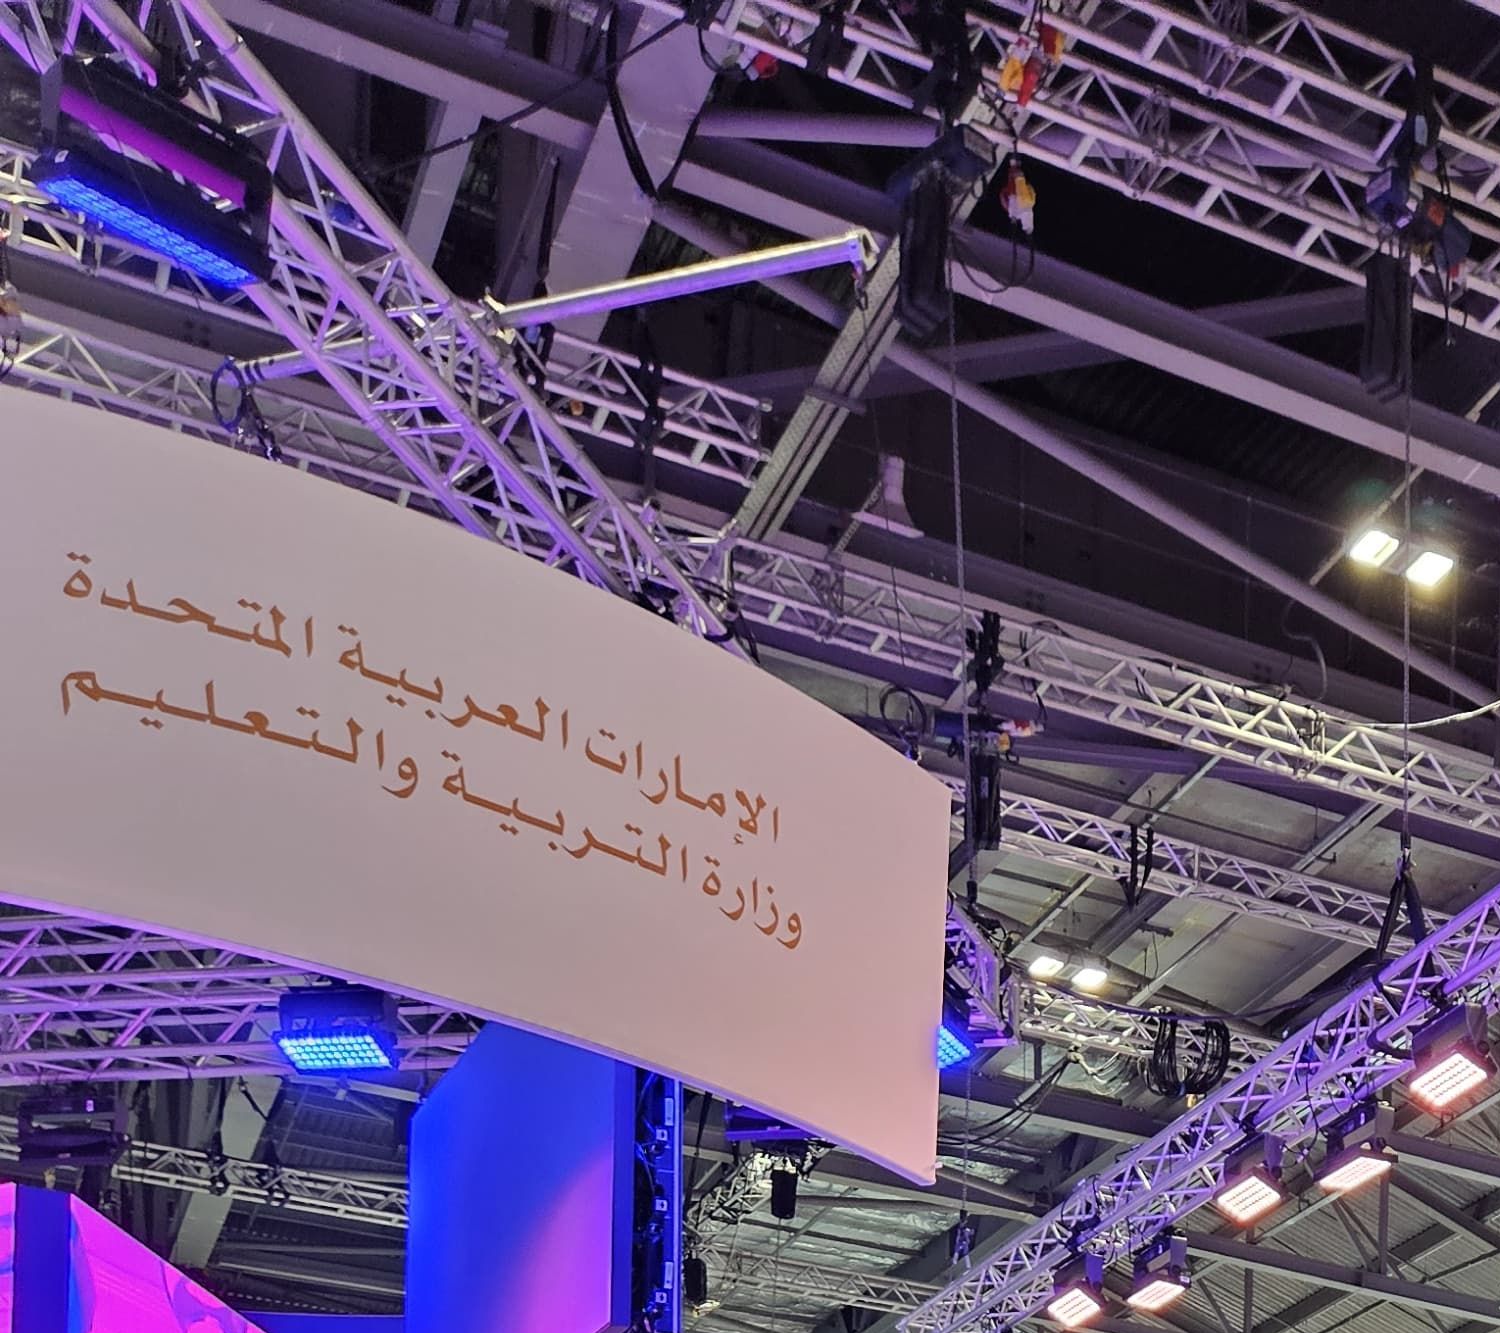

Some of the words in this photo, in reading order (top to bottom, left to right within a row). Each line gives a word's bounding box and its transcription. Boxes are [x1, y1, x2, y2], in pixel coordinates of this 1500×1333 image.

[62, 552, 314, 658] المتحدة
[61, 669, 419, 798] والتعليم
[338, 624, 569, 750] العربية
[441, 750, 689, 881] التربية
[585, 727, 781, 845] الإمارات
[700, 856, 803, 951] وزارة
